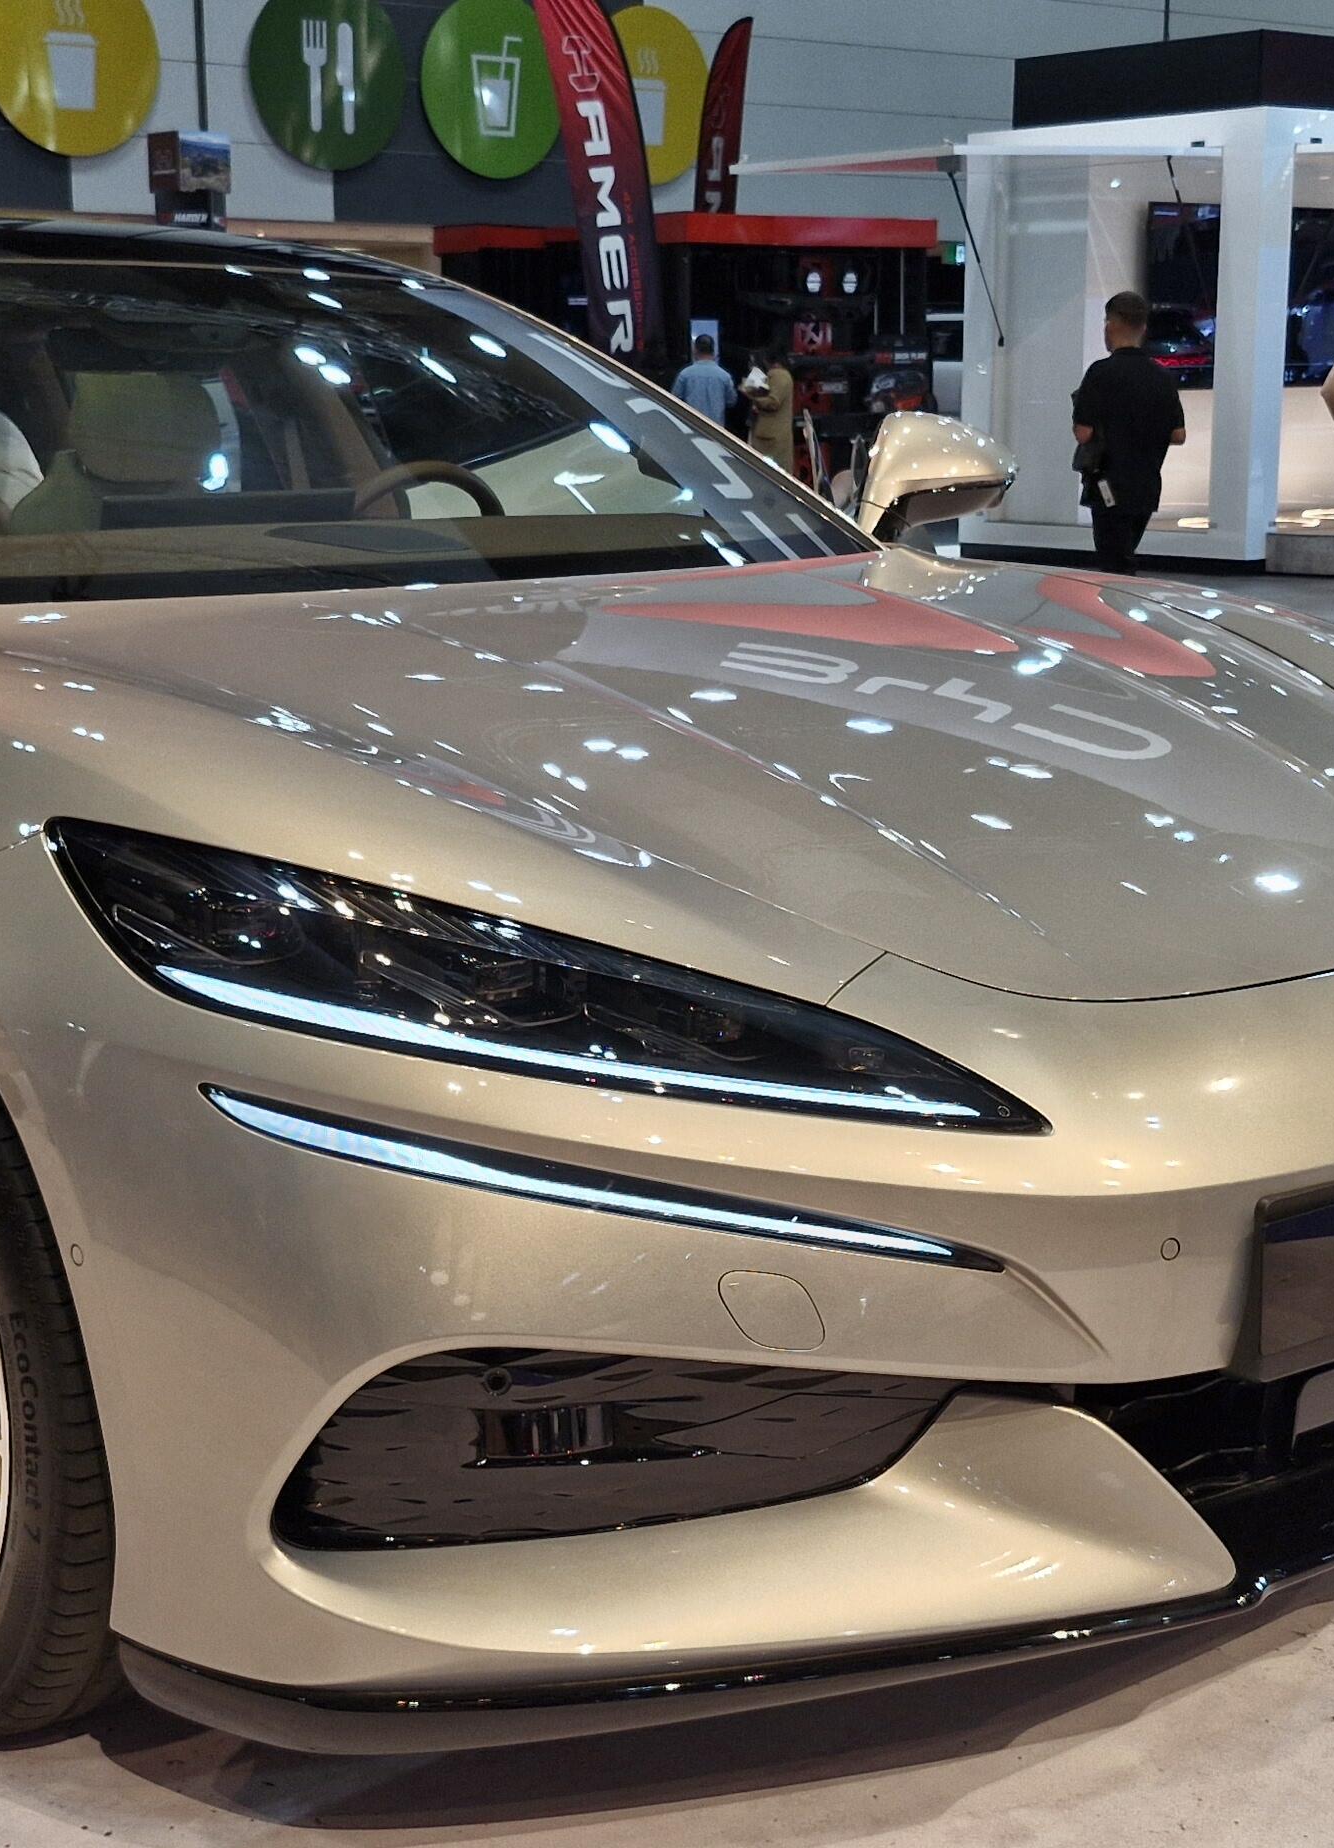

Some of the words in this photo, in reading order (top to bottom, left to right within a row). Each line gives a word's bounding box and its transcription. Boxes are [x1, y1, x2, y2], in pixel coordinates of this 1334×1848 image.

[562, 35, 634, 354] HAMER
[9, 1310, 43, 1512] EcoContact
[22, 1521, 43, 1546] 7
